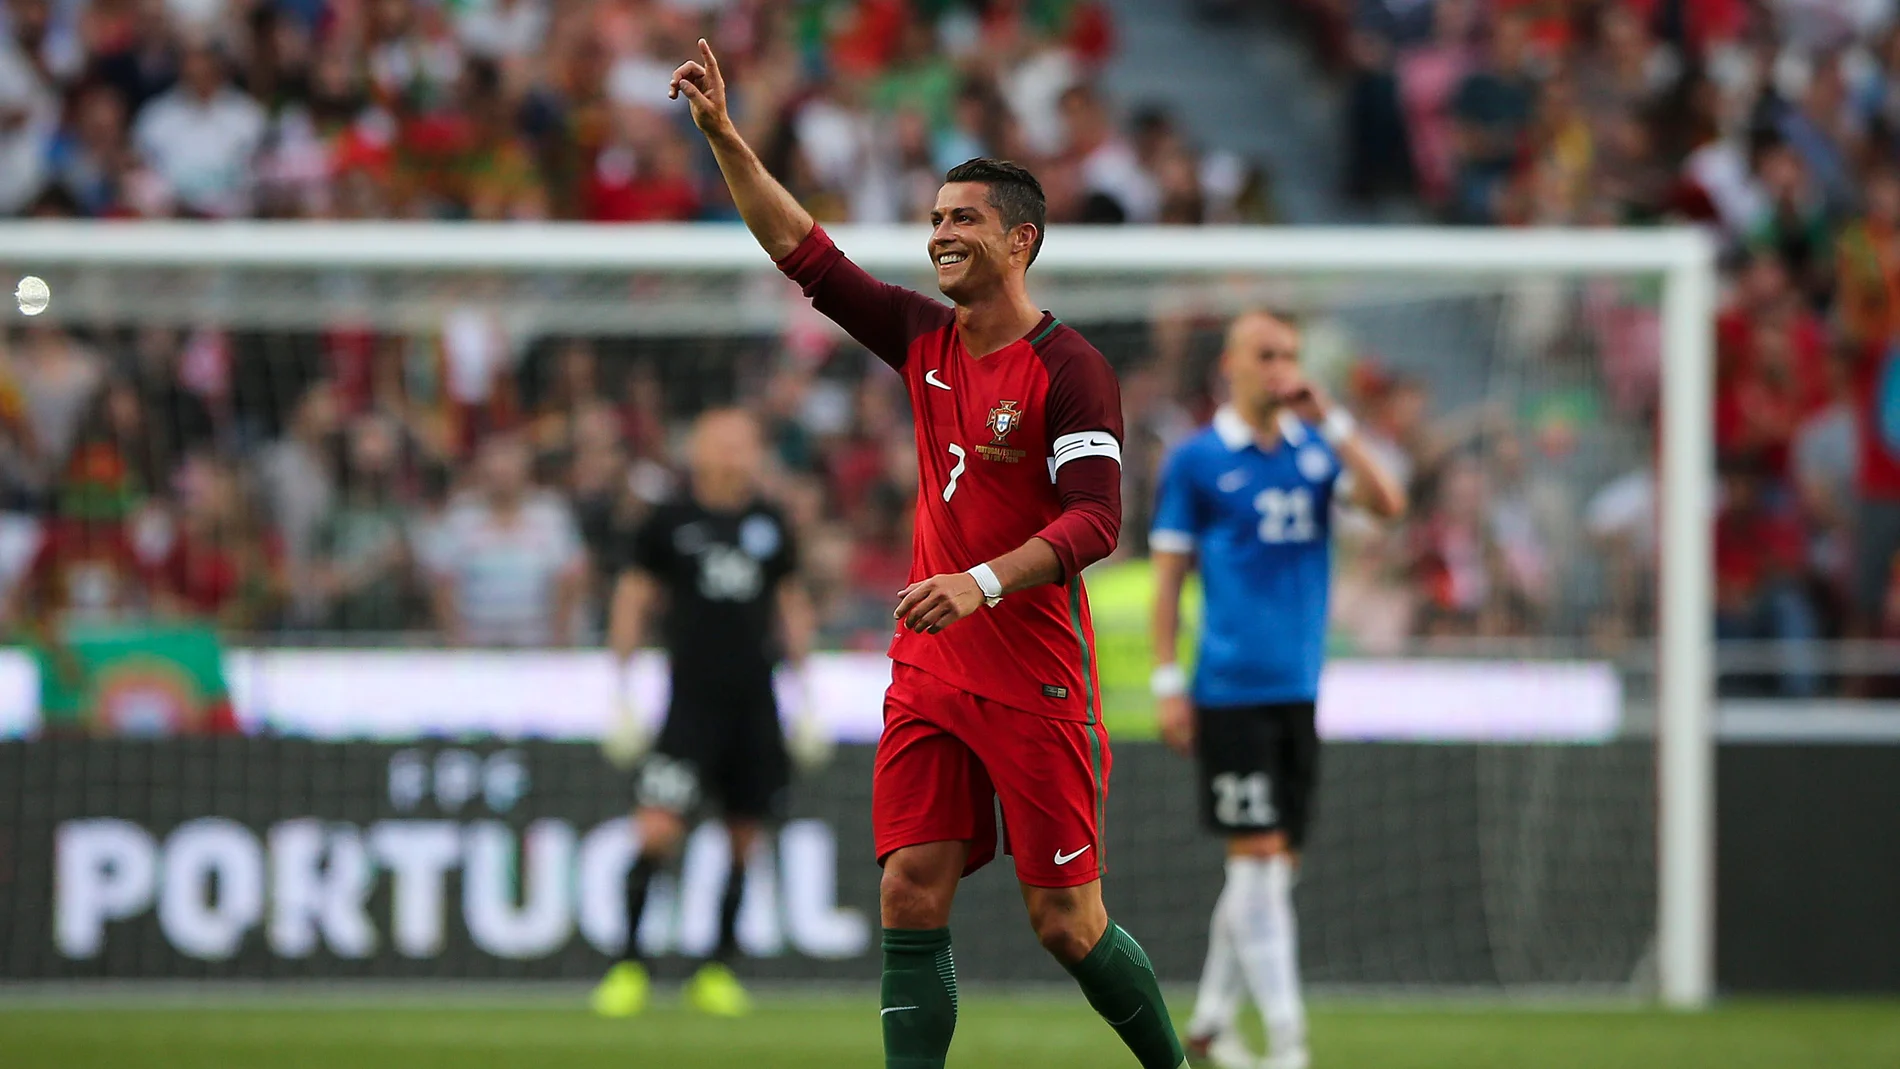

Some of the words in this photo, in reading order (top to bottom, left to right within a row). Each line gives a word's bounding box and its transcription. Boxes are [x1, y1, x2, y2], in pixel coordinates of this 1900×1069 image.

[943, 443, 966, 502] 7
[1254, 487, 1316, 544] 21
[1212, 772, 1277, 827] 21
